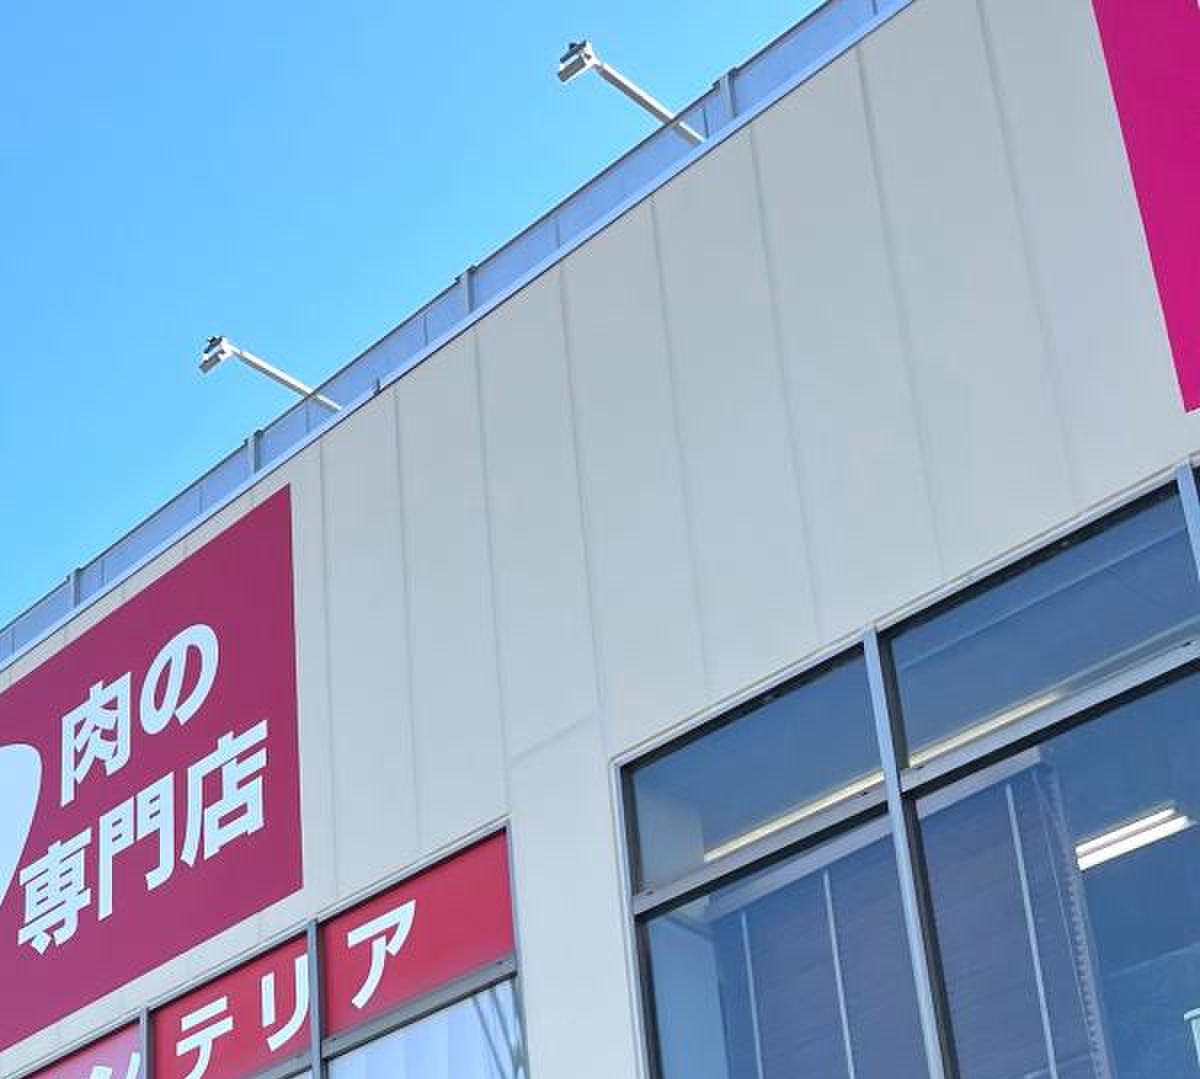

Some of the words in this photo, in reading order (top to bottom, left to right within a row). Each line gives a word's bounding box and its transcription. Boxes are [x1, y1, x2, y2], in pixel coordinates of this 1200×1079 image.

[60, 623, 220, 806] 肉の
[17, 719, 268, 955] 専門店
